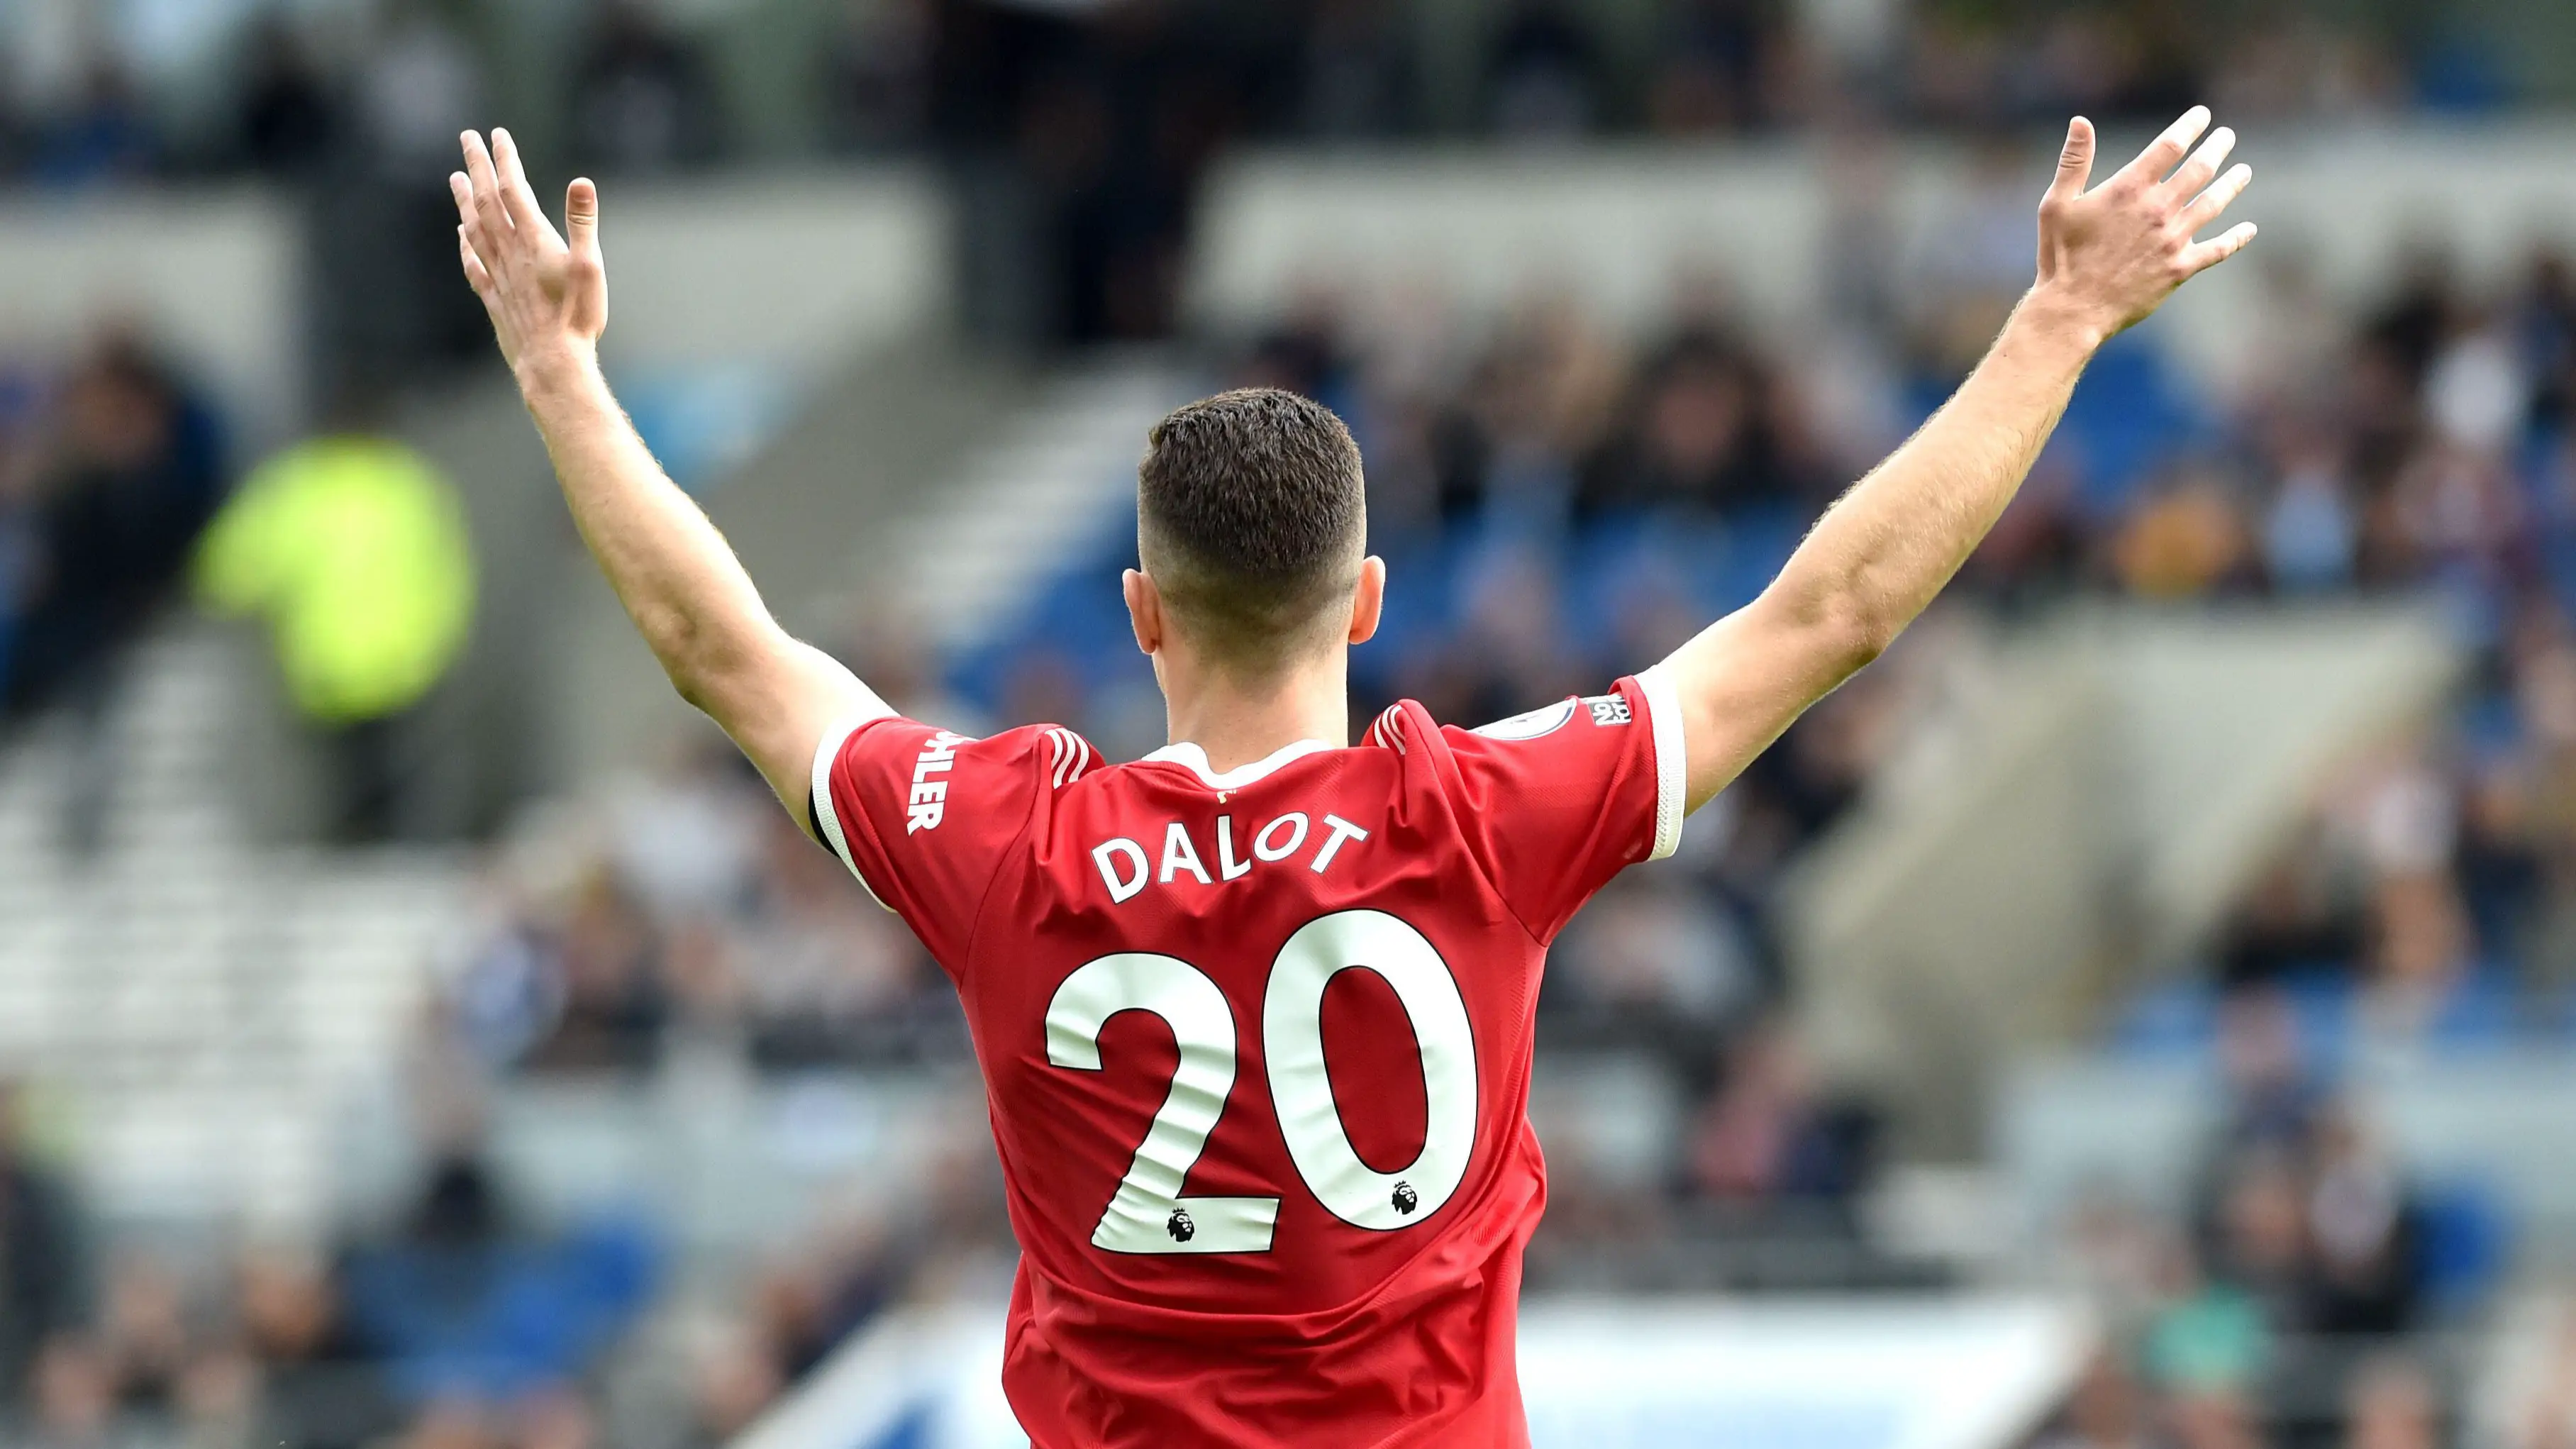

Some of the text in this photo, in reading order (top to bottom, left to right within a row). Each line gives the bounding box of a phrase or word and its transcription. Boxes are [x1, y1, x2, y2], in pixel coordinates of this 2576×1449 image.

[906, 731, 963, 836] HLER
[1091, 811, 1370, 904] DALOT
[1045, 909, 1479, 1254] 20
